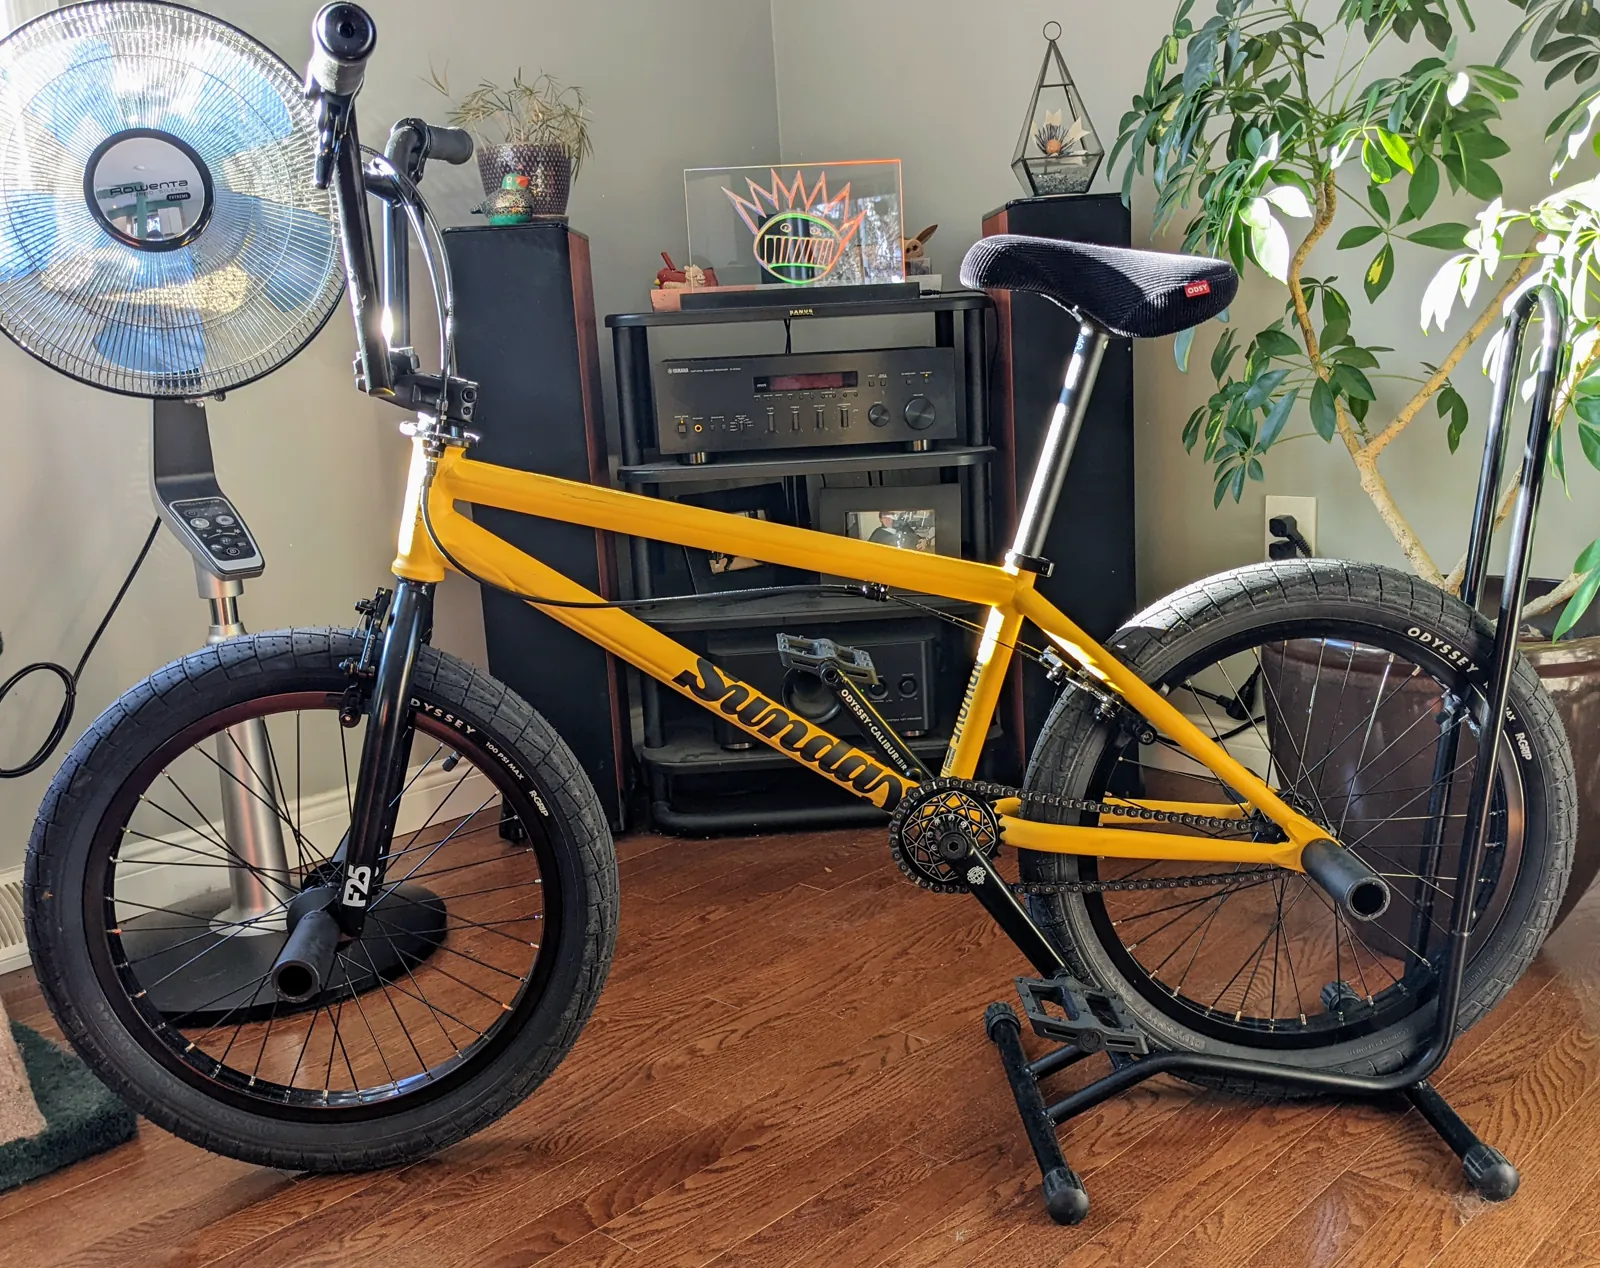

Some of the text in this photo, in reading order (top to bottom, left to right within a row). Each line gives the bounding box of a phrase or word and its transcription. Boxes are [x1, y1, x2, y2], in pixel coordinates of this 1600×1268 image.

[1187, 284, 1207, 294] ODSY
[1407, 627, 1479, 673] ODYSSEY
[410, 698, 476, 734] DYSSEY
[841, 689, 872, 725] ODYSSEY
[1505, 706, 1517, 722] AX
[485, 741, 525, 780] 100 PSI MAX
[342, 864, 371, 907] F25
